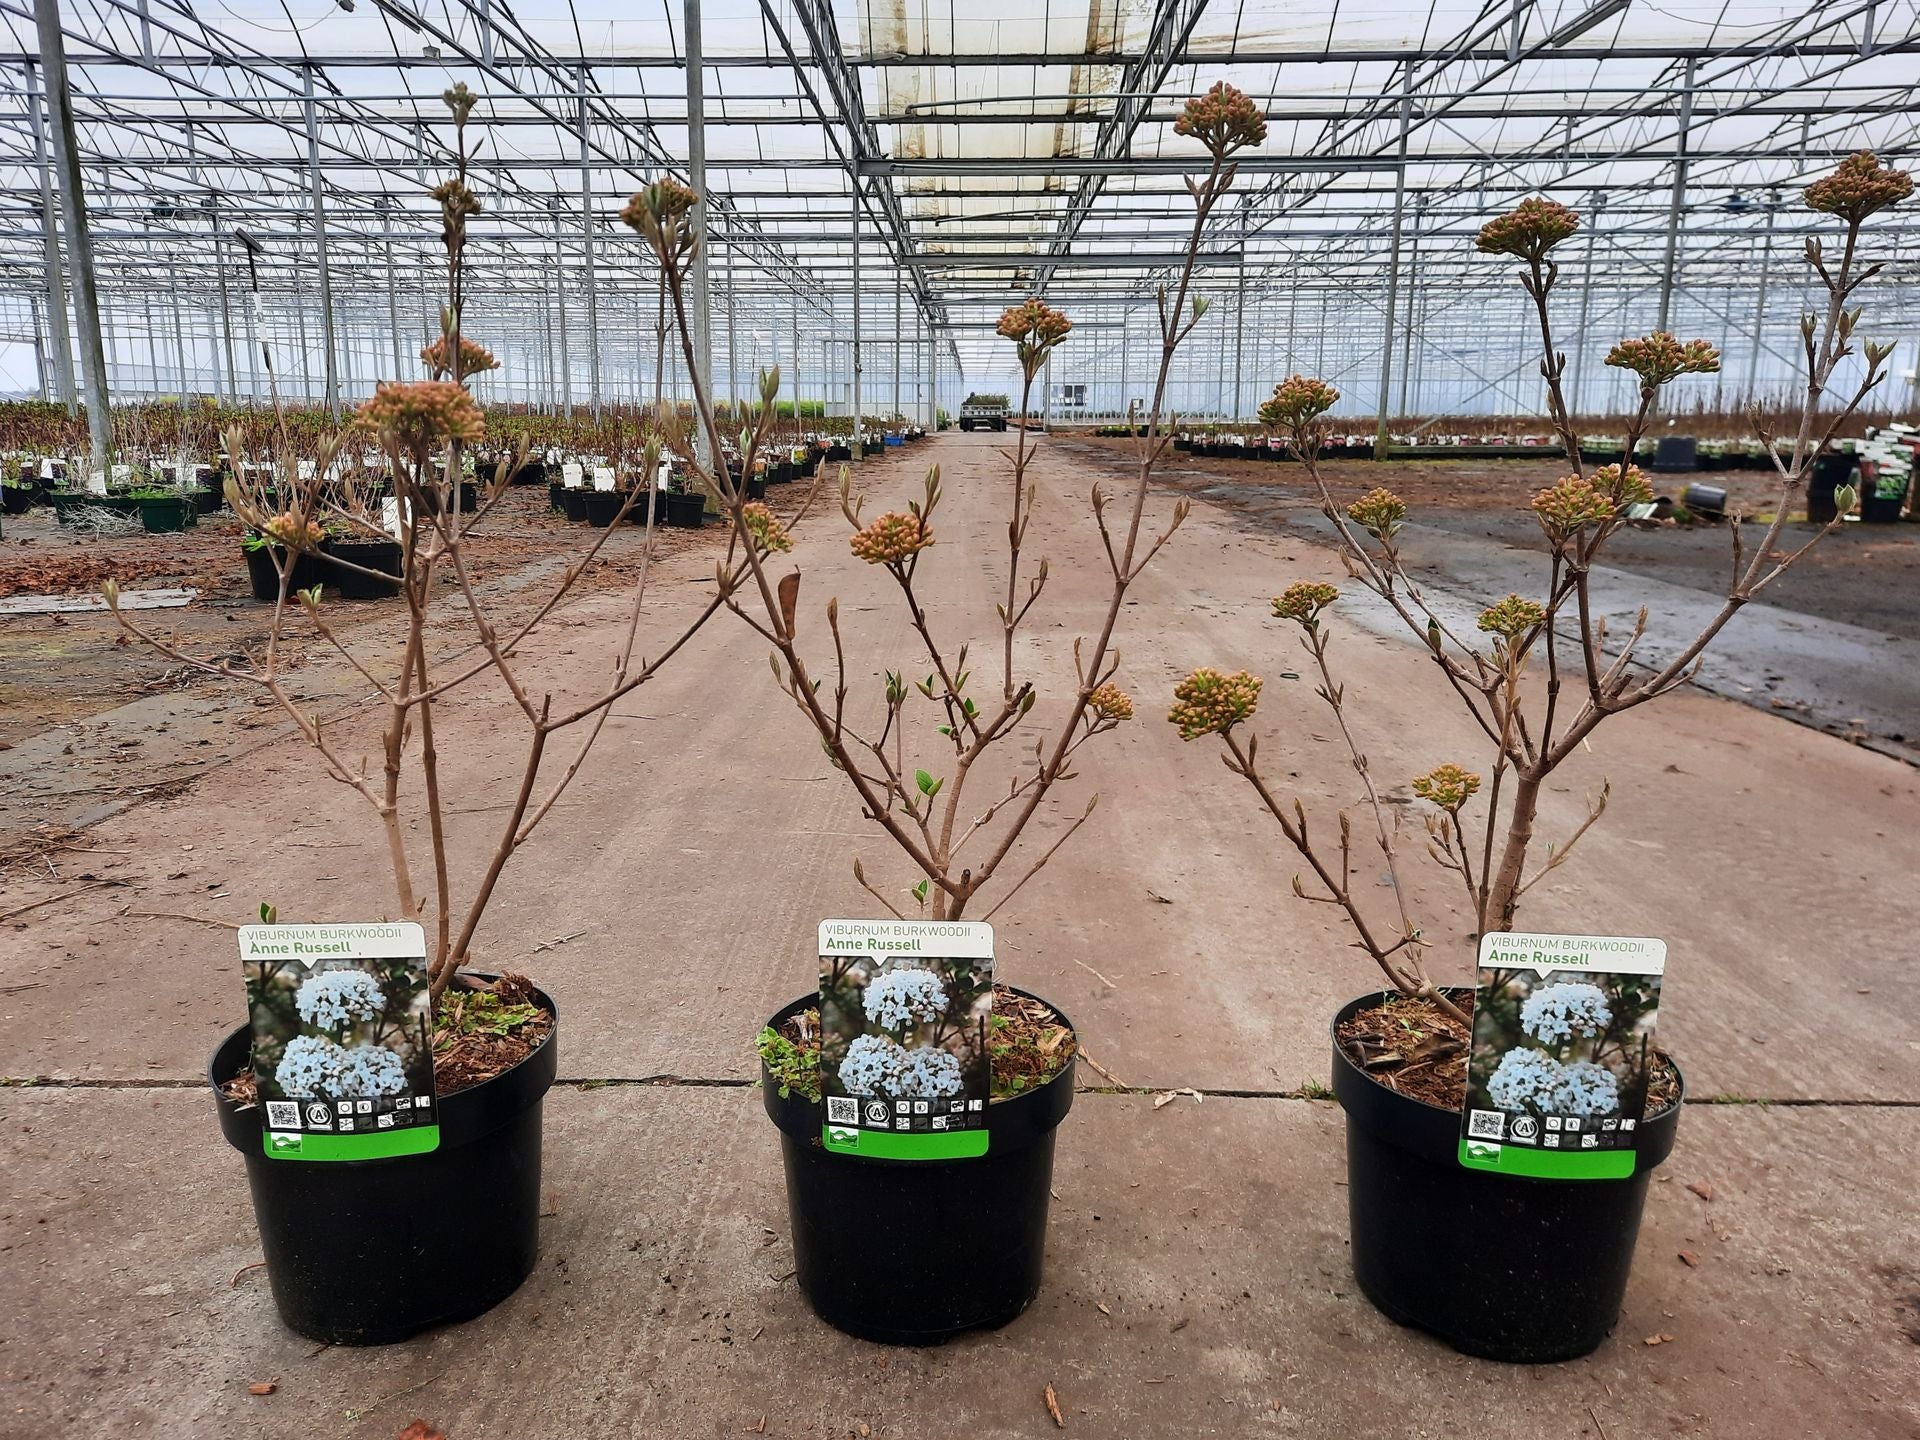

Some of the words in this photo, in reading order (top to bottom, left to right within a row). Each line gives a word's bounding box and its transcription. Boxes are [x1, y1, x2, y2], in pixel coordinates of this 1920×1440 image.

[246, 928, 316, 941] VIBURNUM
[320, 927, 402, 940] BURKWOODII
[825, 924, 890, 936] VIBURNUM
[893, 925, 971, 937] BURKWOODII
[250, 942, 289, 954] Anne
[294, 941, 352, 954] Russell
[826, 937, 863, 950] Anne
[867, 938, 922, 951] Russell
[1490, 936, 1558, 950] VIBURNUM
[1562, 939, 1645, 953] BURKWOODII
[1488, 949, 1528, 962] Anne
[1532, 951, 1590, 965] Russell
